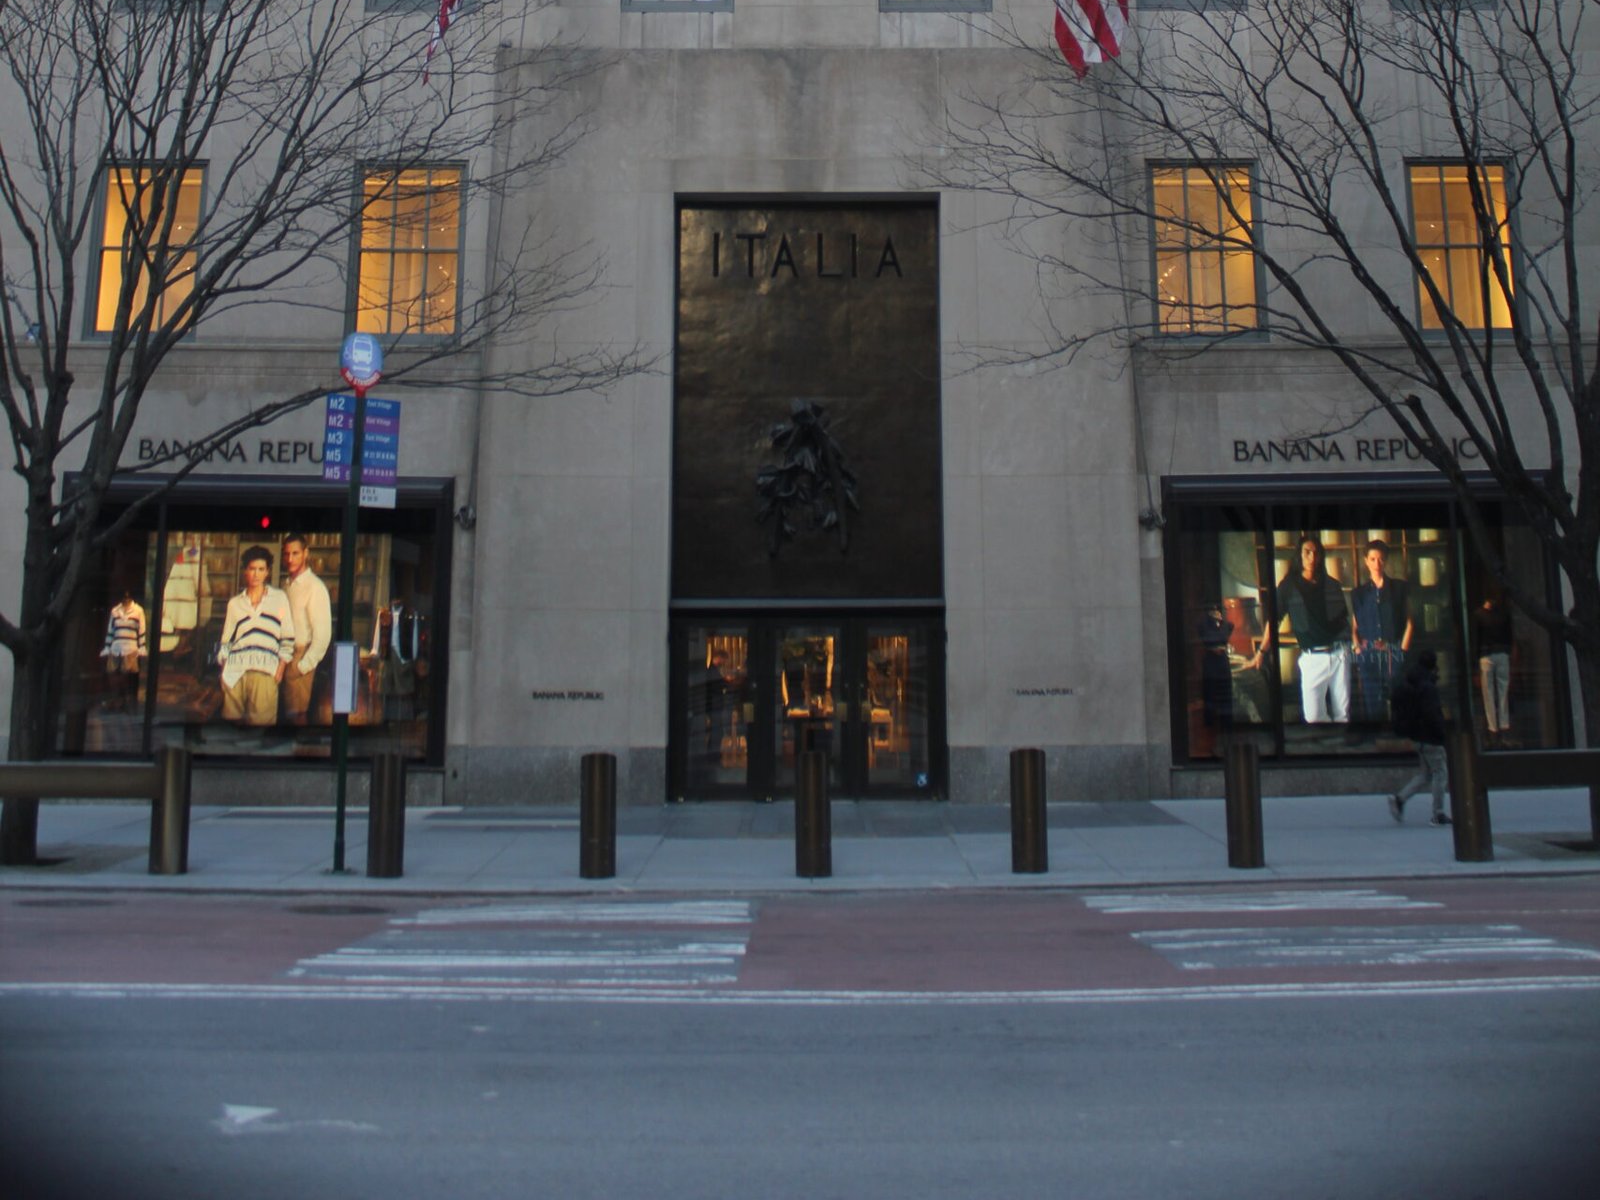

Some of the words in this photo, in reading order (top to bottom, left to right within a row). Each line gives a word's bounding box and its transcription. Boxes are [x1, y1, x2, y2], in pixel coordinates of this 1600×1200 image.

[712, 232, 903, 278] ITALIA
[329, 397, 345, 410] M2
[328, 414, 344, 428] M2
[327, 431, 343, 445] M3
[138, 439, 247, 463] BANANA
[326, 449, 342, 462] M5
[1233, 440, 1345, 462] BANANA
[325, 466, 341, 480] M5
